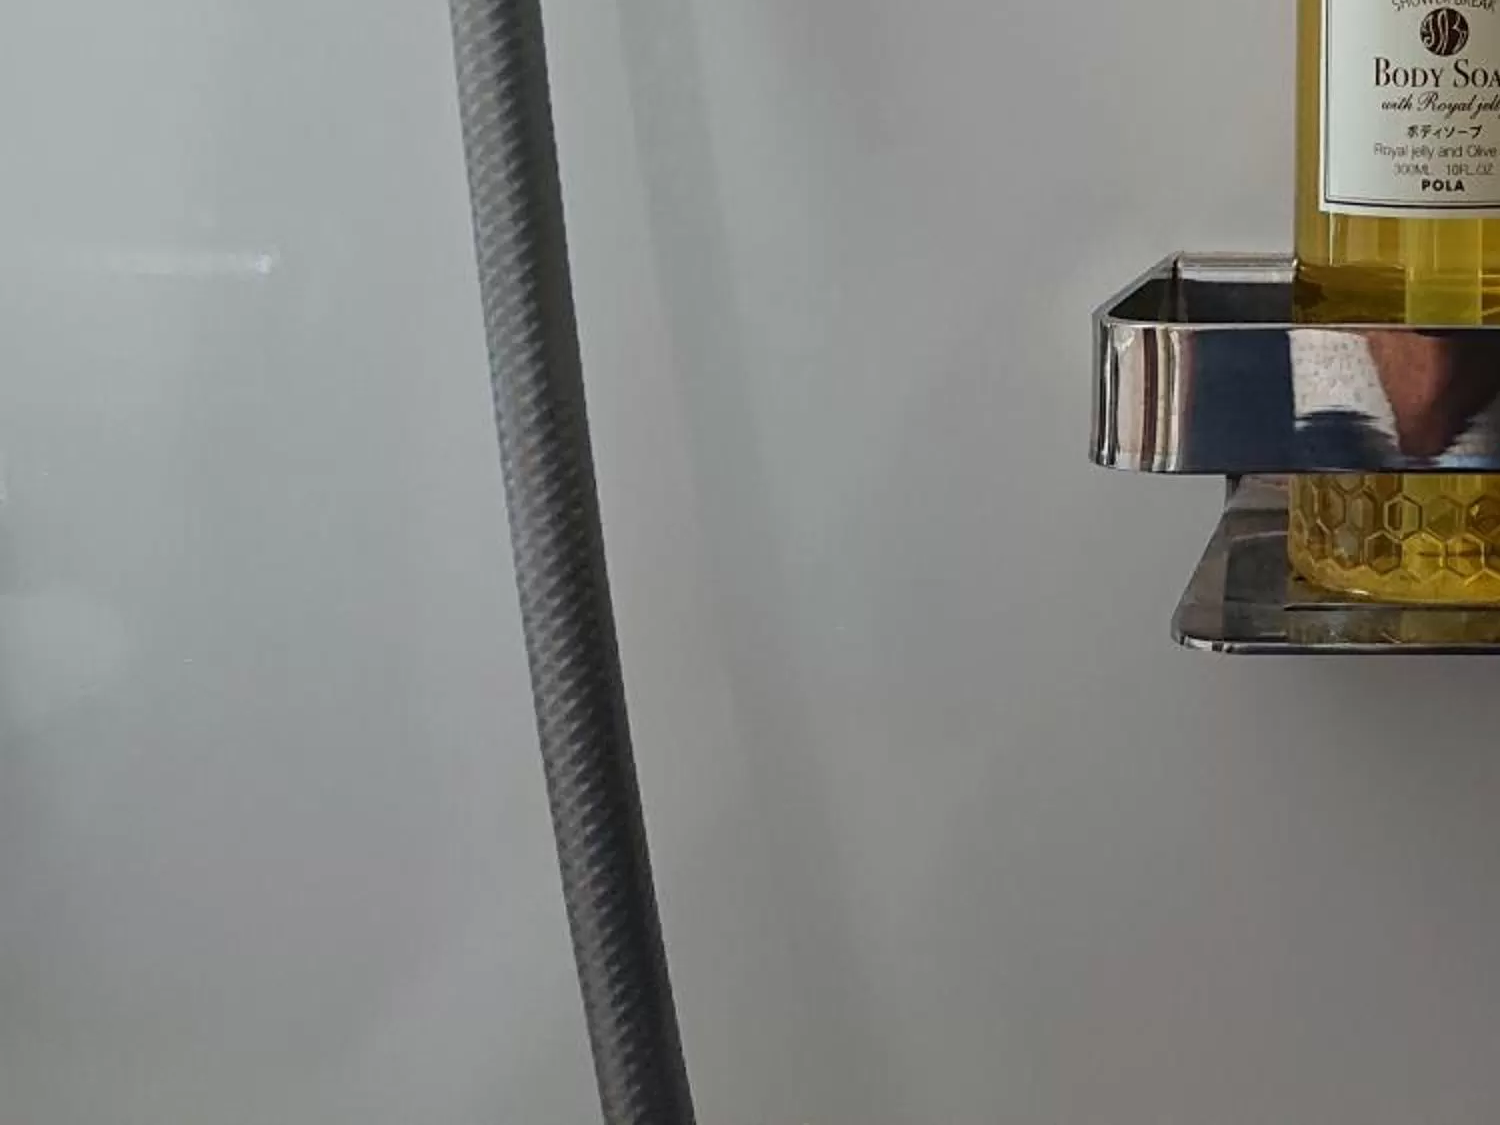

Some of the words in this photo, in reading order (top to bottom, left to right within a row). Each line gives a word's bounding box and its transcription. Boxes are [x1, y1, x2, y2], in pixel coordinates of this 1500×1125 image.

[1374, 57, 1445, 88] BODY
[1381, 93, 1414, 112] with
[1417, 91, 1478, 118] Royal
[1407, 124, 1483, 139] ボディソープ
[1374, 142, 1409, 161] Royal
[1411, 144, 1435, 162] jelly
[1438, 144, 1463, 158] and
[1467, 144, 1498, 158] Olive
[1421, 179, 1465, 192] POLA
